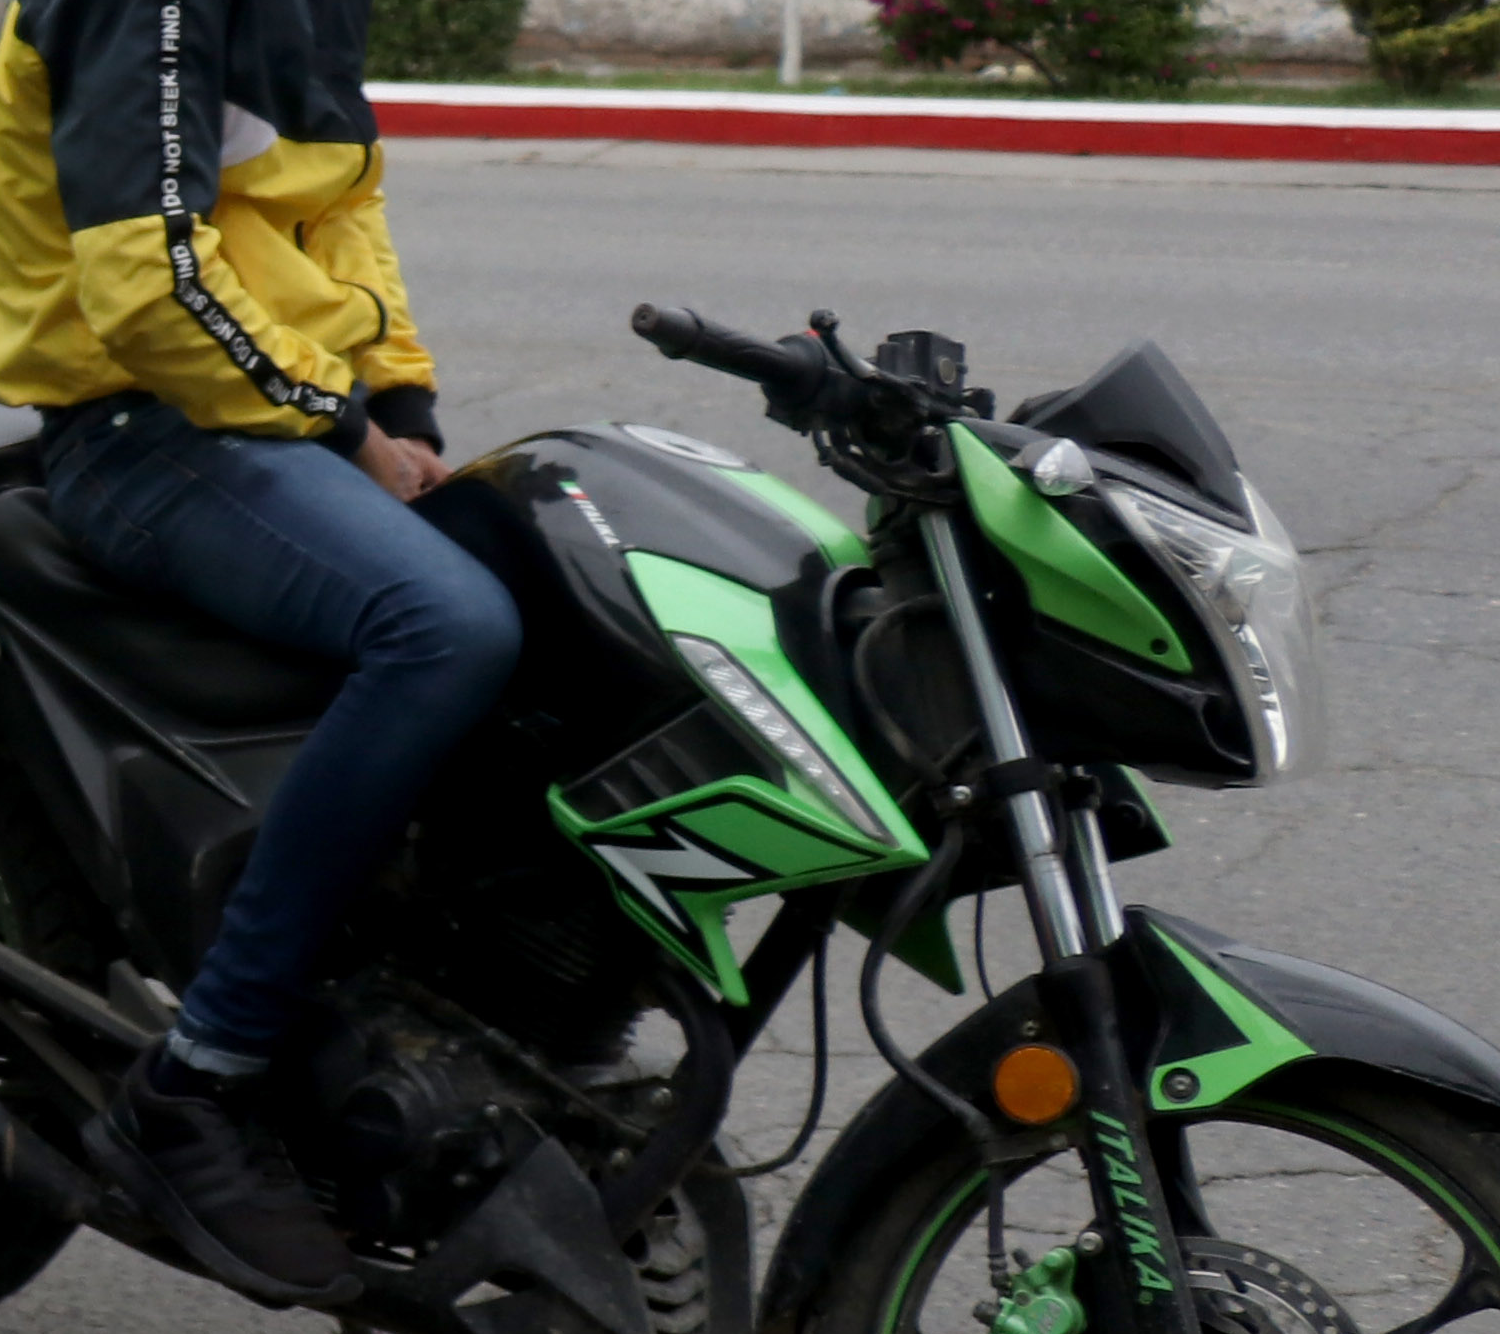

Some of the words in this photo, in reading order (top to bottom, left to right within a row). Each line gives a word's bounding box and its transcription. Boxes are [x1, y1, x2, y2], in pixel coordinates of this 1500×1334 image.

[160, 0, 181, 53] FIND.
[159, 68, 181, 127] SEEK,
[161, 130, 182, 173] NOT
[160, 178, 183, 208] DO
[164, 208, 186, 217] I
[1088, 1109, 1175, 1292] ITALIKA
